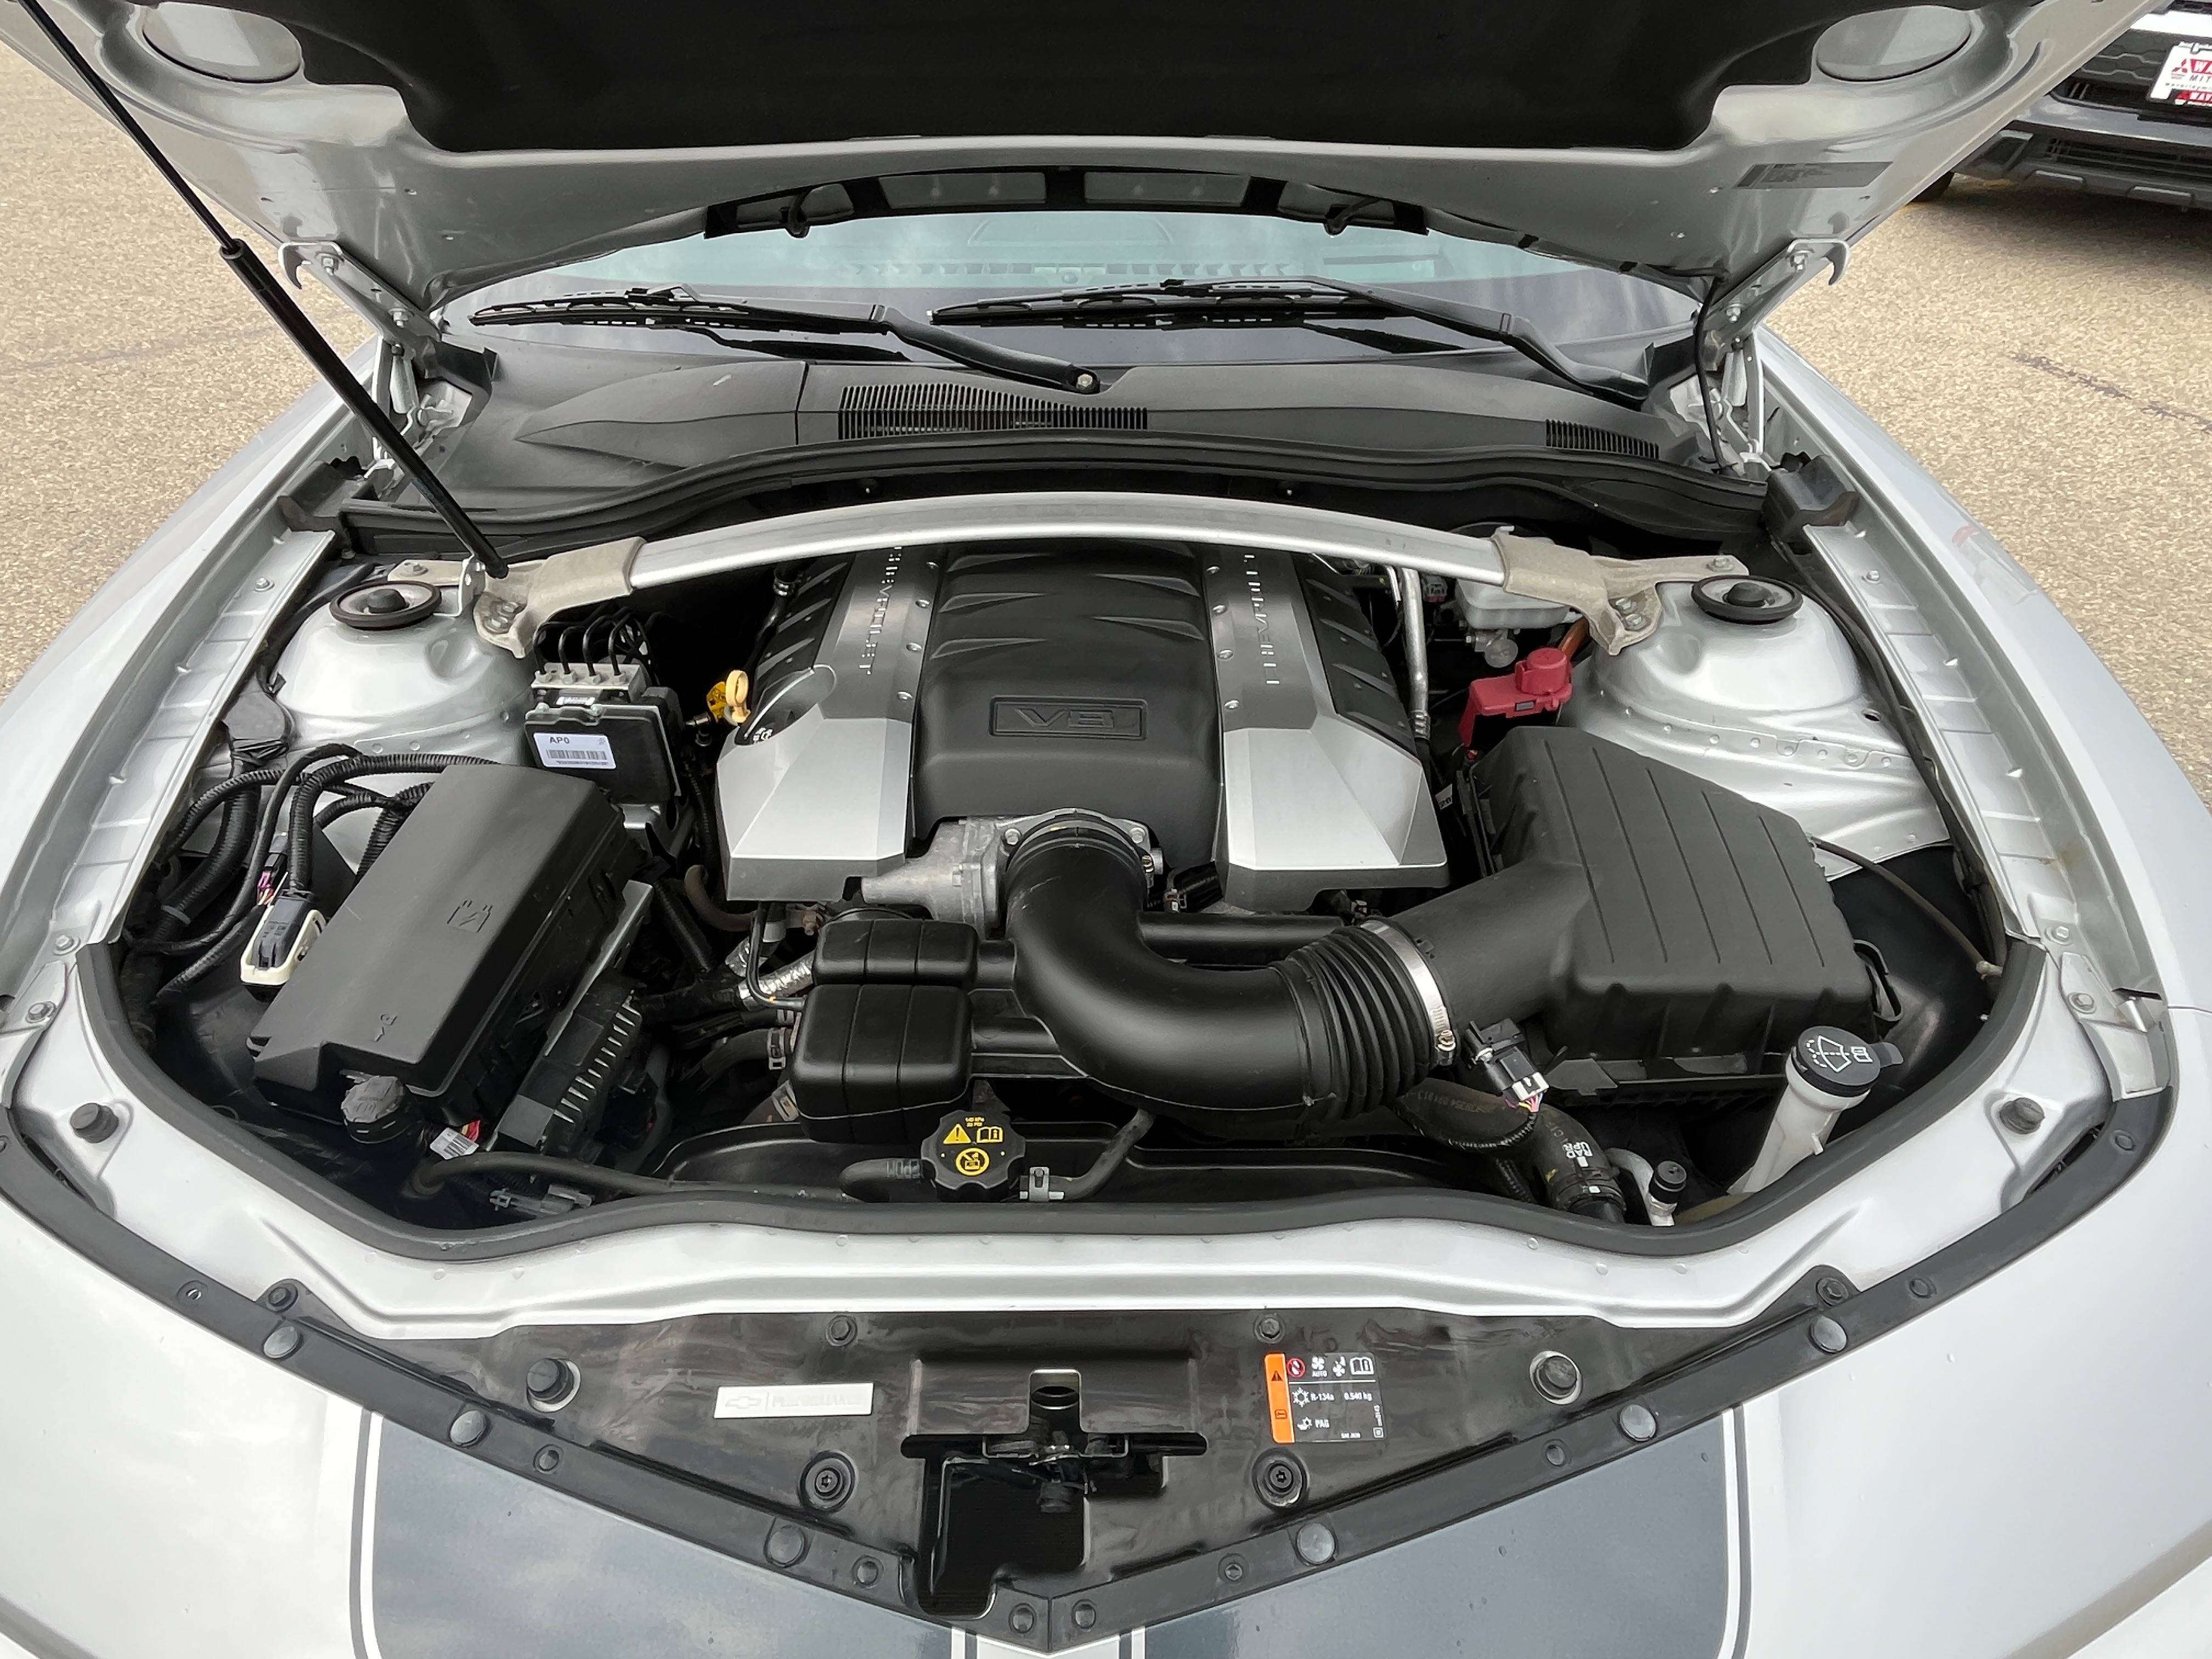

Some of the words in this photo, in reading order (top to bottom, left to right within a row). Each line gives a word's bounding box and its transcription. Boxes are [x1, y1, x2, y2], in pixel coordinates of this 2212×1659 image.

[1015, 708, 1114, 728] V8
[1310, 1392, 1335, 1401] R-134a
[1363, 1392, 1373, 1401] kg
[1314, 1419, 1330, 1428] PAG
